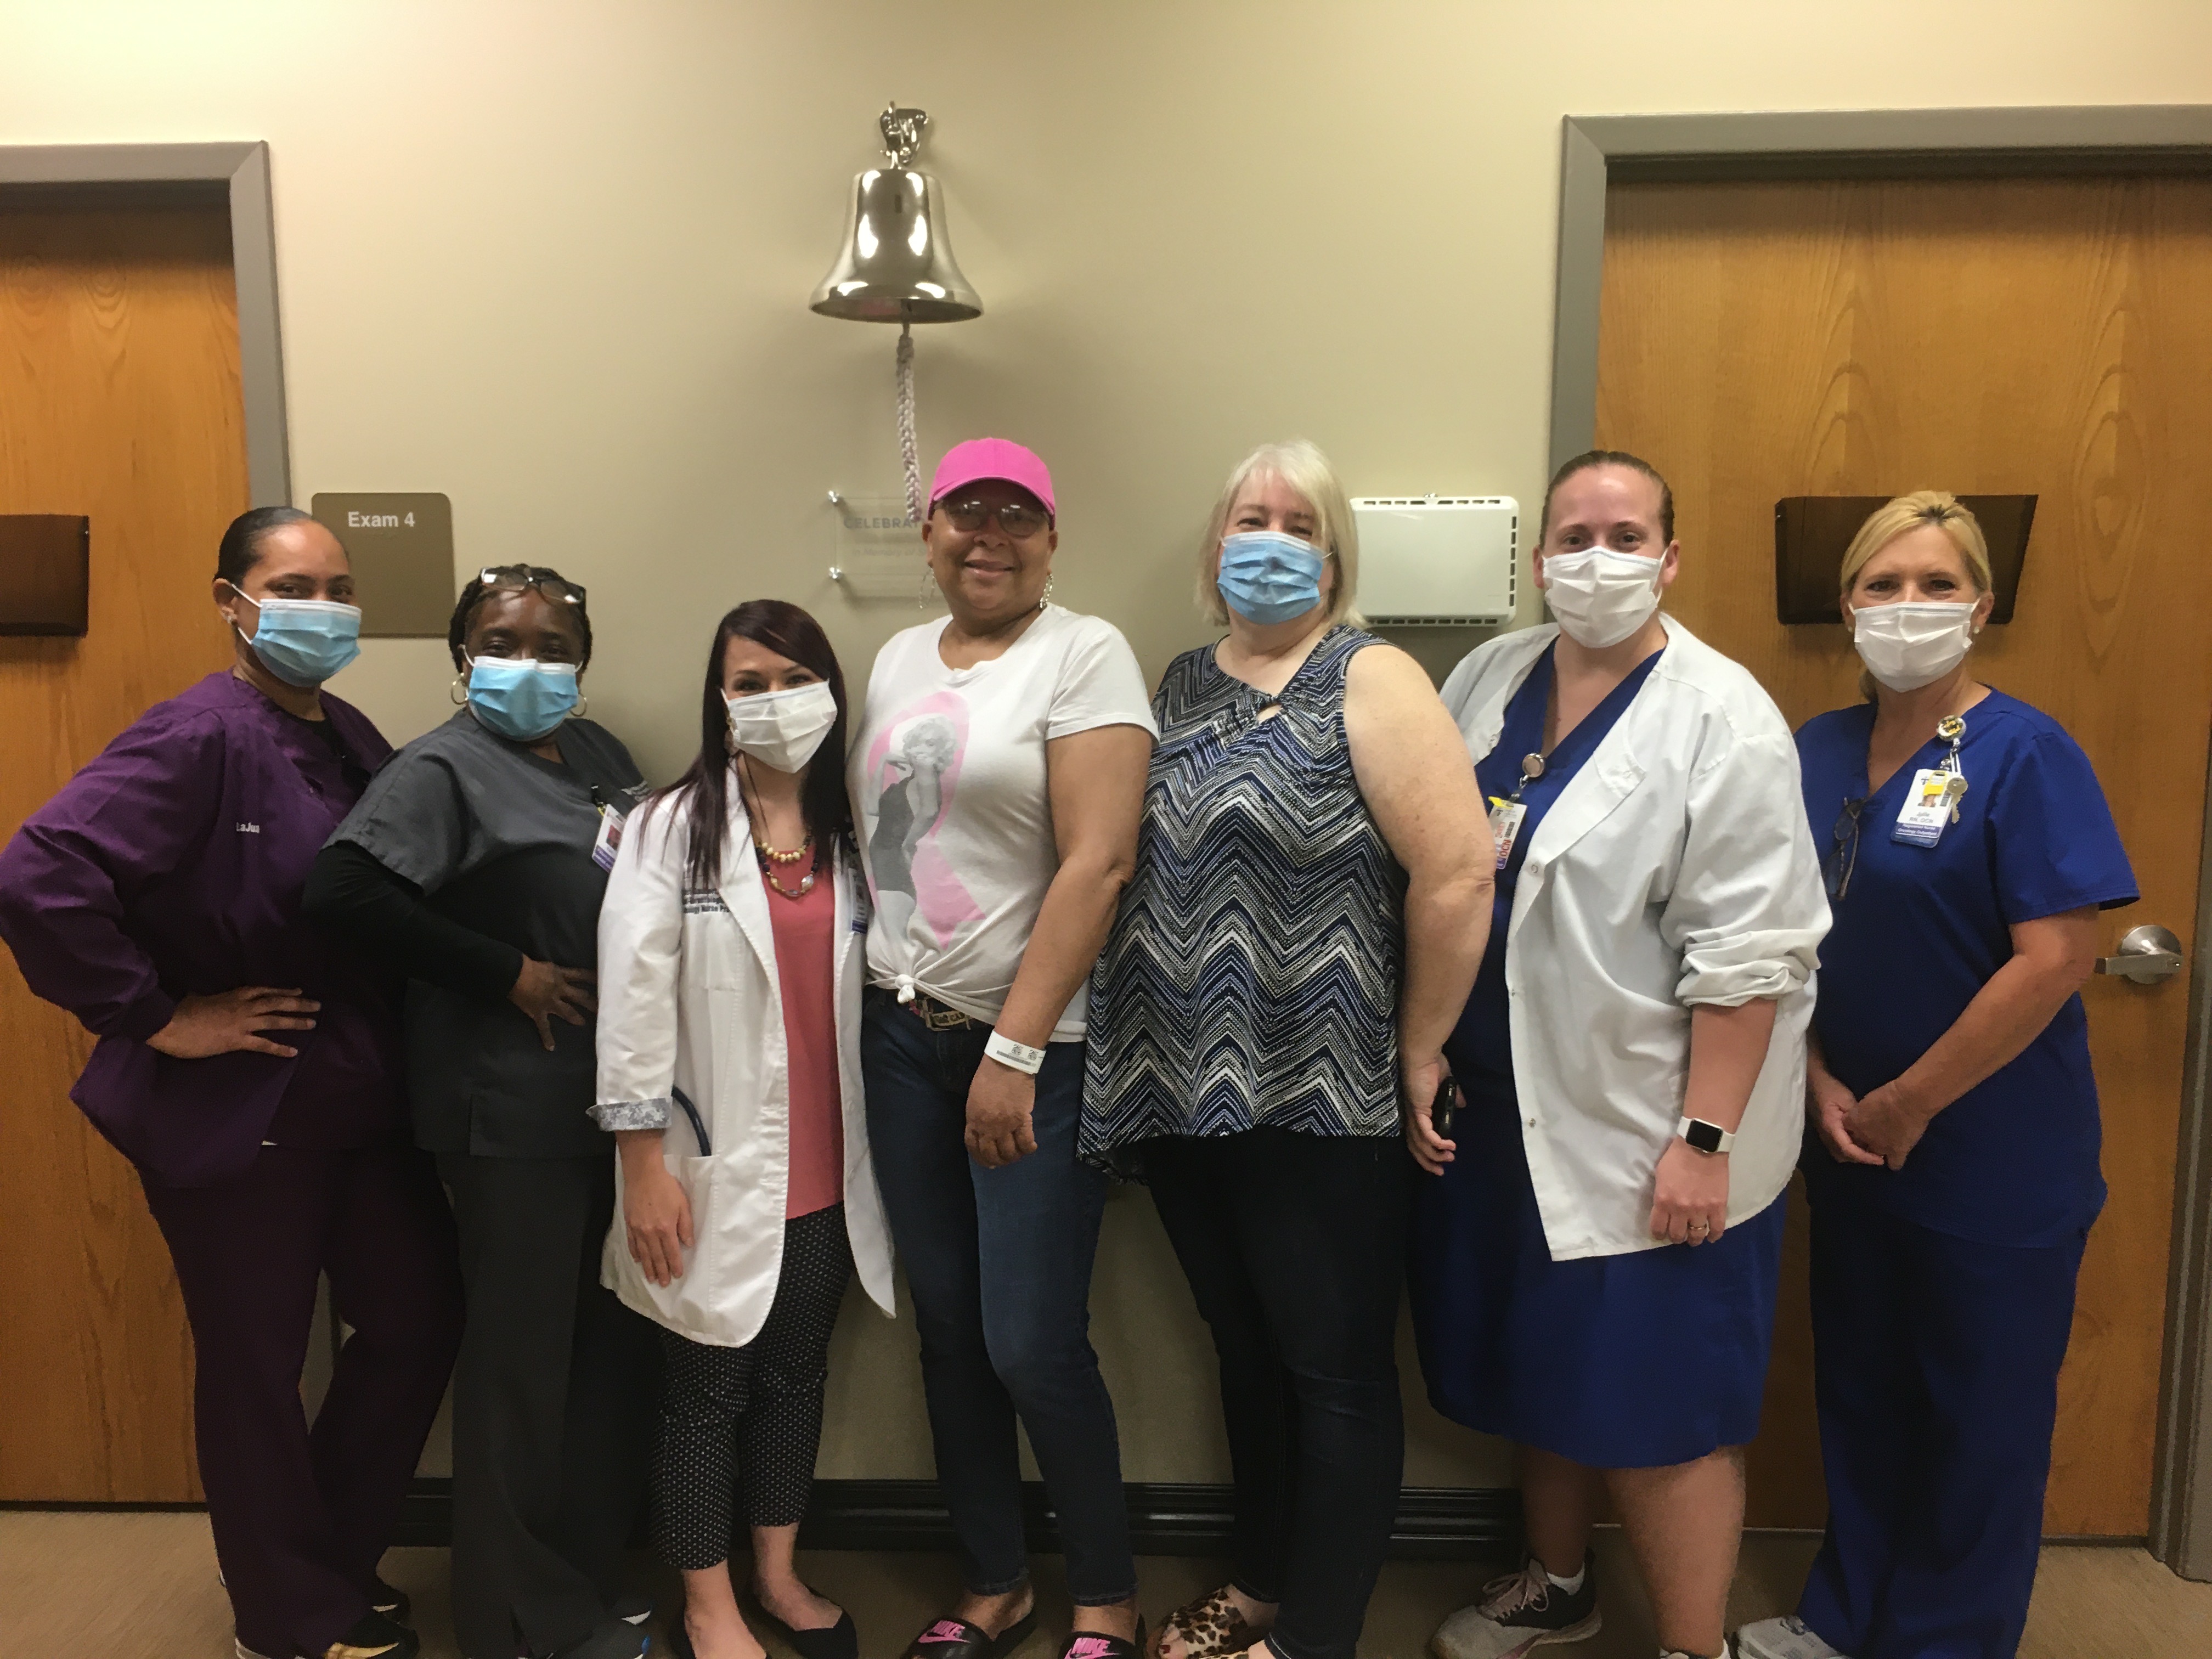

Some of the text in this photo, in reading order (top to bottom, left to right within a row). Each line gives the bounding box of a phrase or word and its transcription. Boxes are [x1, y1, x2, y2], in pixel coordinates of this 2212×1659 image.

[348, 511, 415, 527] Exam 4
[931, 1620, 966, 1636] NIKE
[1070, 1638, 1111, 1654] NIKE
